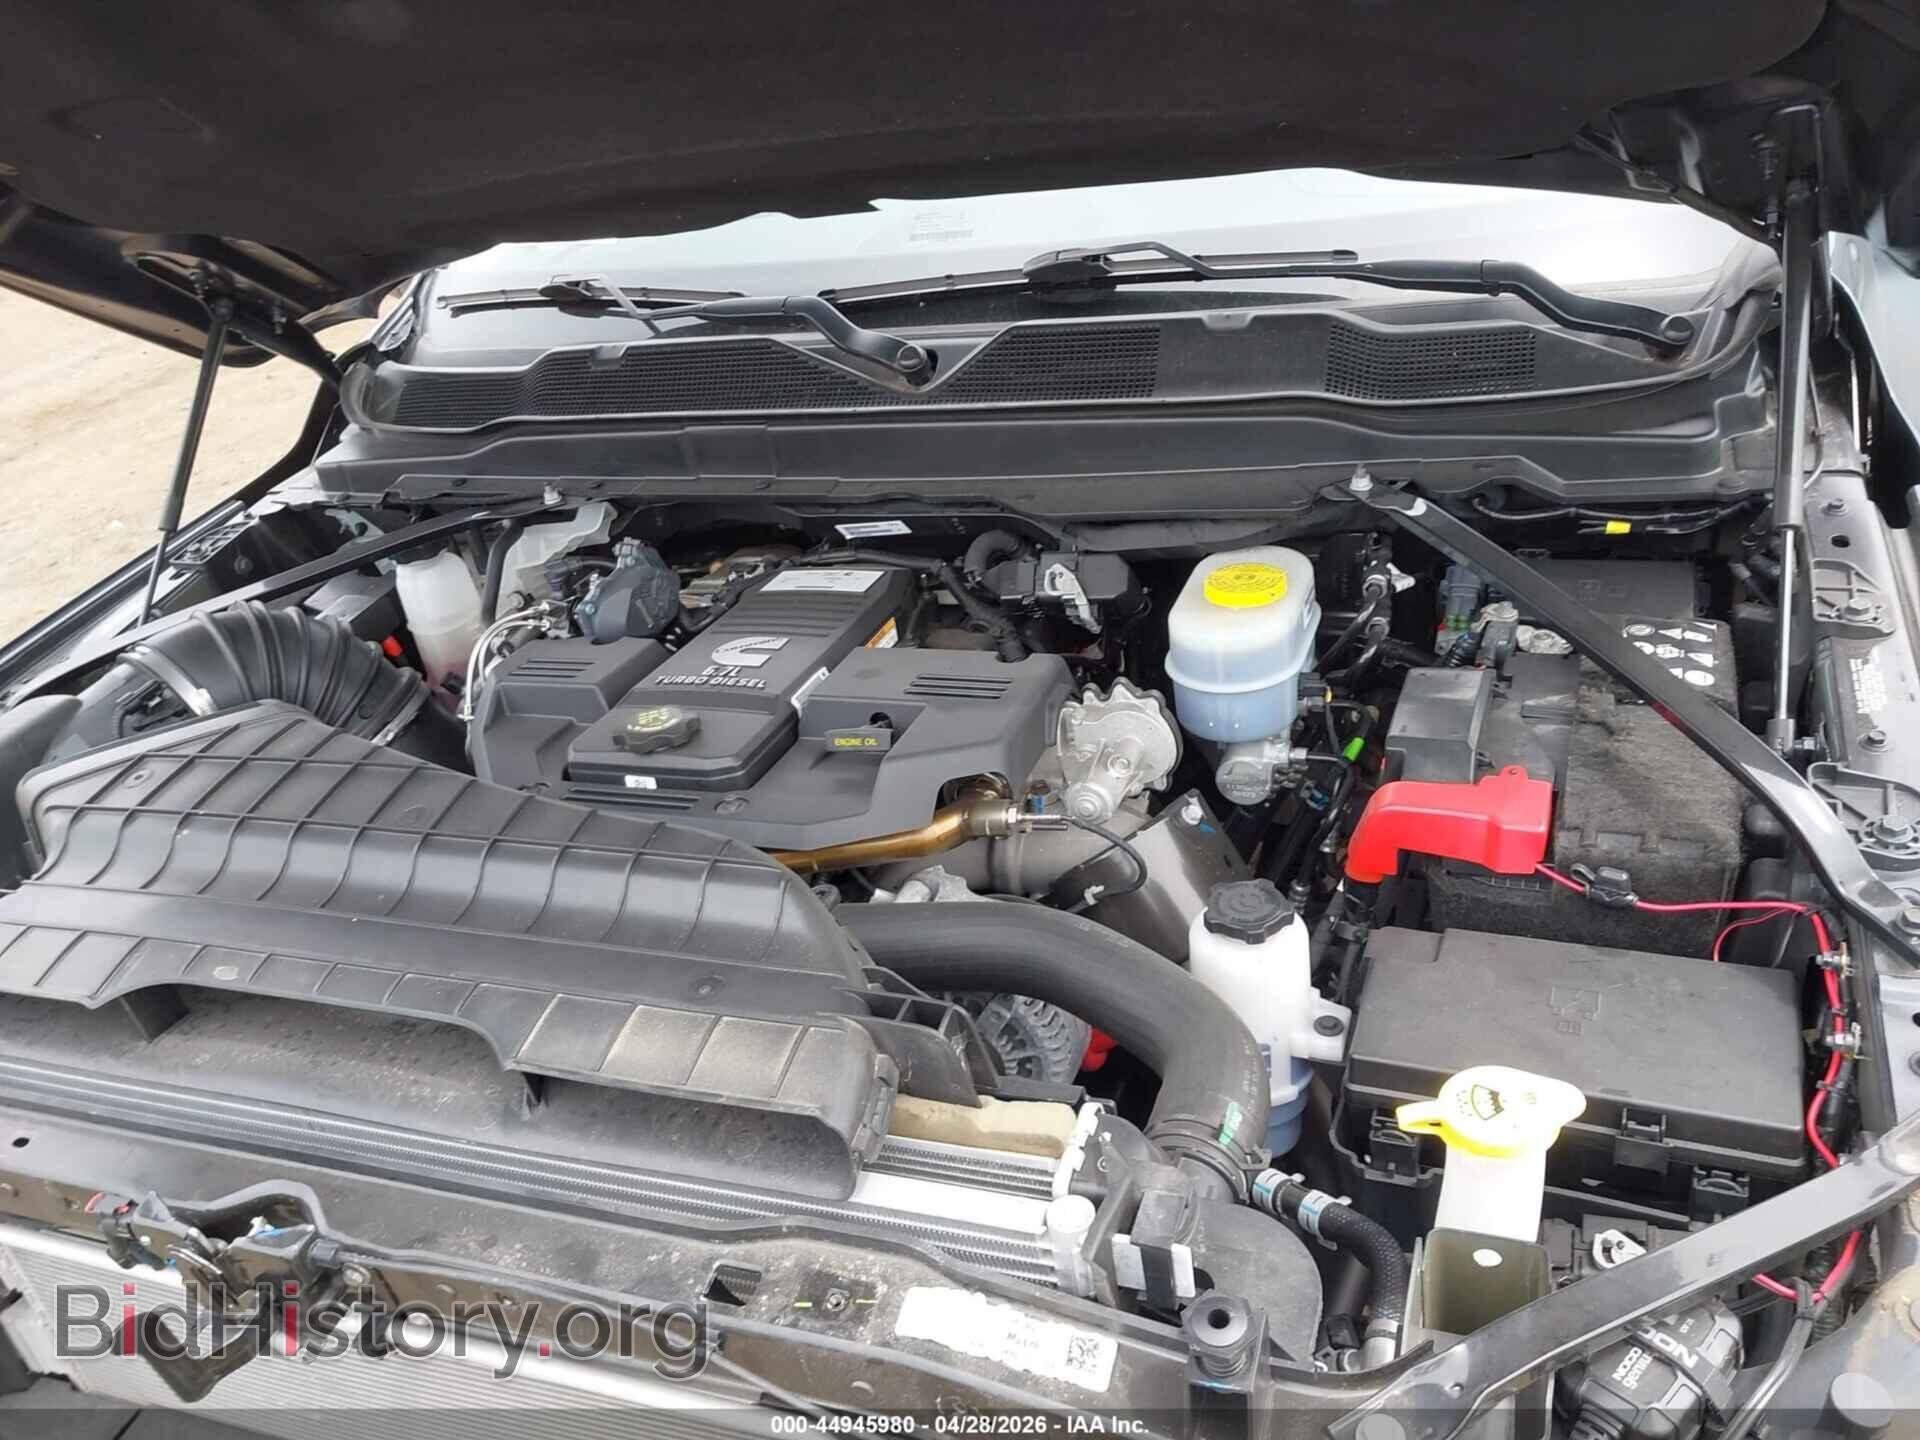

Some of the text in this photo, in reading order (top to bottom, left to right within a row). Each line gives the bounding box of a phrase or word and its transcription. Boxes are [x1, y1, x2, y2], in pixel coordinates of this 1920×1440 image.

[655, 675, 767, 688] TURBO DIESEL
[702, 665, 742, 676] 6.7L
[1637, 1326, 1699, 1369] NOC
[1611, 1346, 1643, 1381] NOCO
